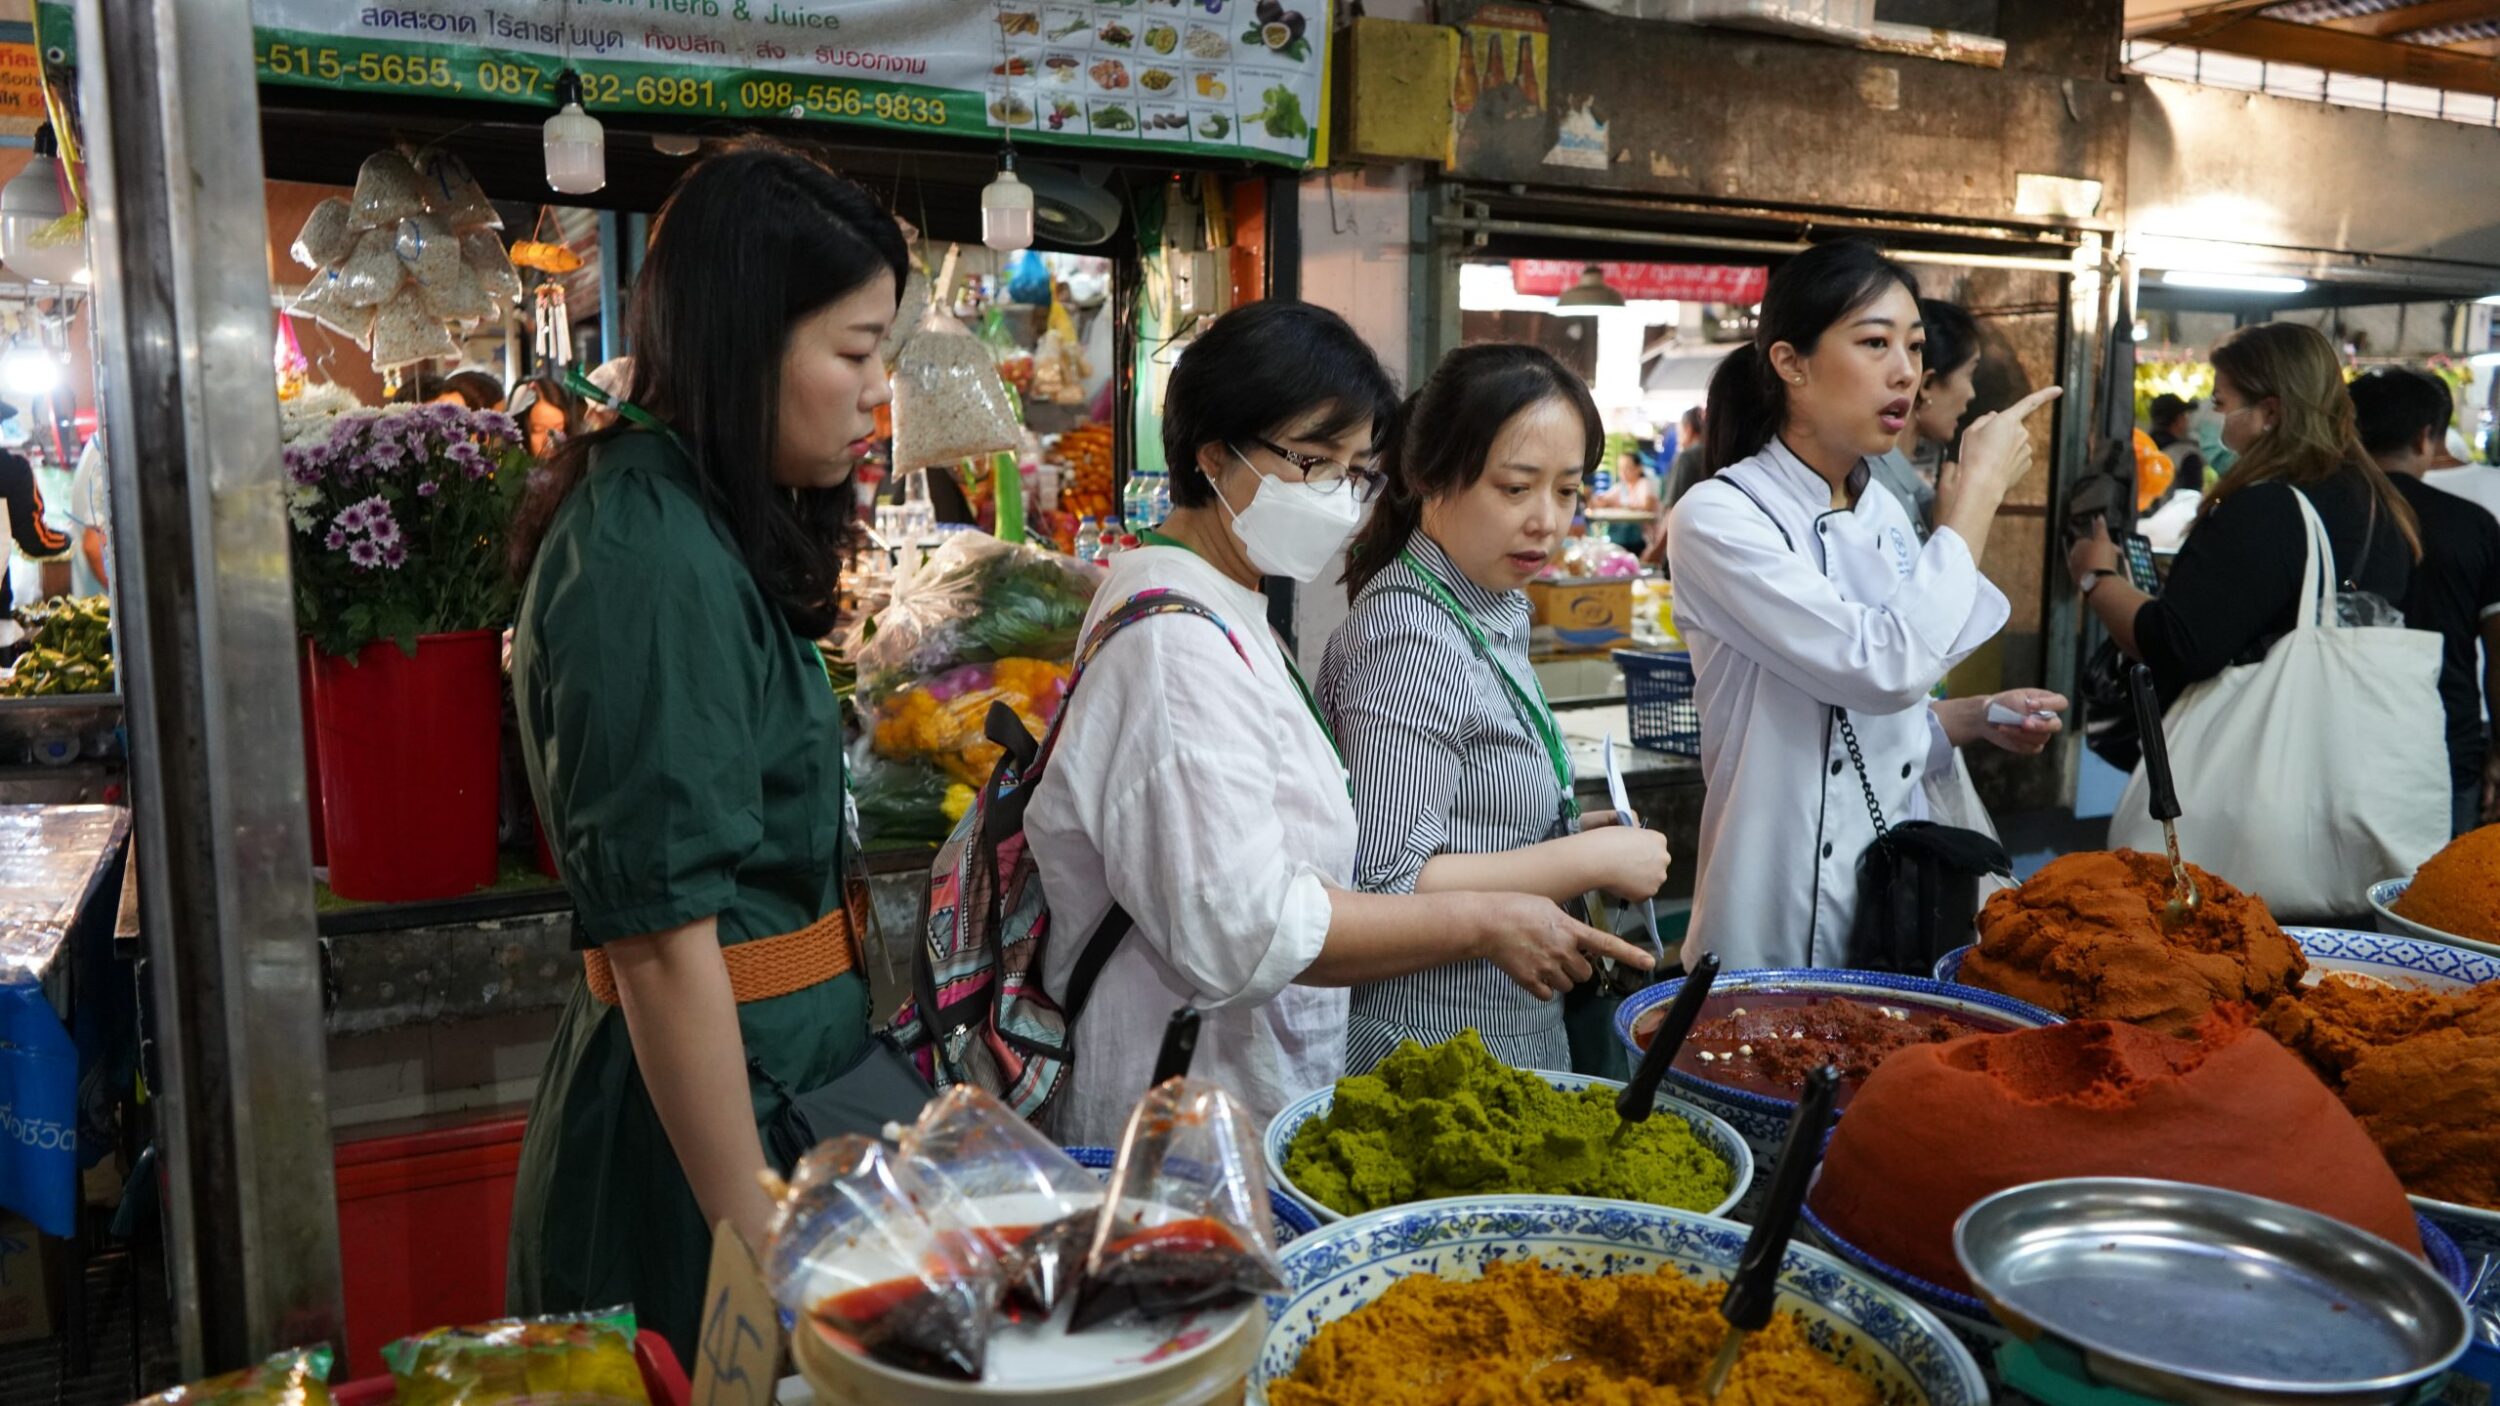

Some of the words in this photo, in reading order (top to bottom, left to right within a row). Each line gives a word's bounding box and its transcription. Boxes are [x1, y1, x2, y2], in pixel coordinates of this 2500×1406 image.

[361, 7, 476, 34] สดสะอาด
[756, 40, 786, 59] ส่ง
[815, 44, 926, 74] รับออกงาน
[733, 1, 751, 20] &
[764, 4, 840, 29] Juice
[478, 62, 728, 111] 087-82-6981,
[741, 81, 947, 124] 098-556-9833
